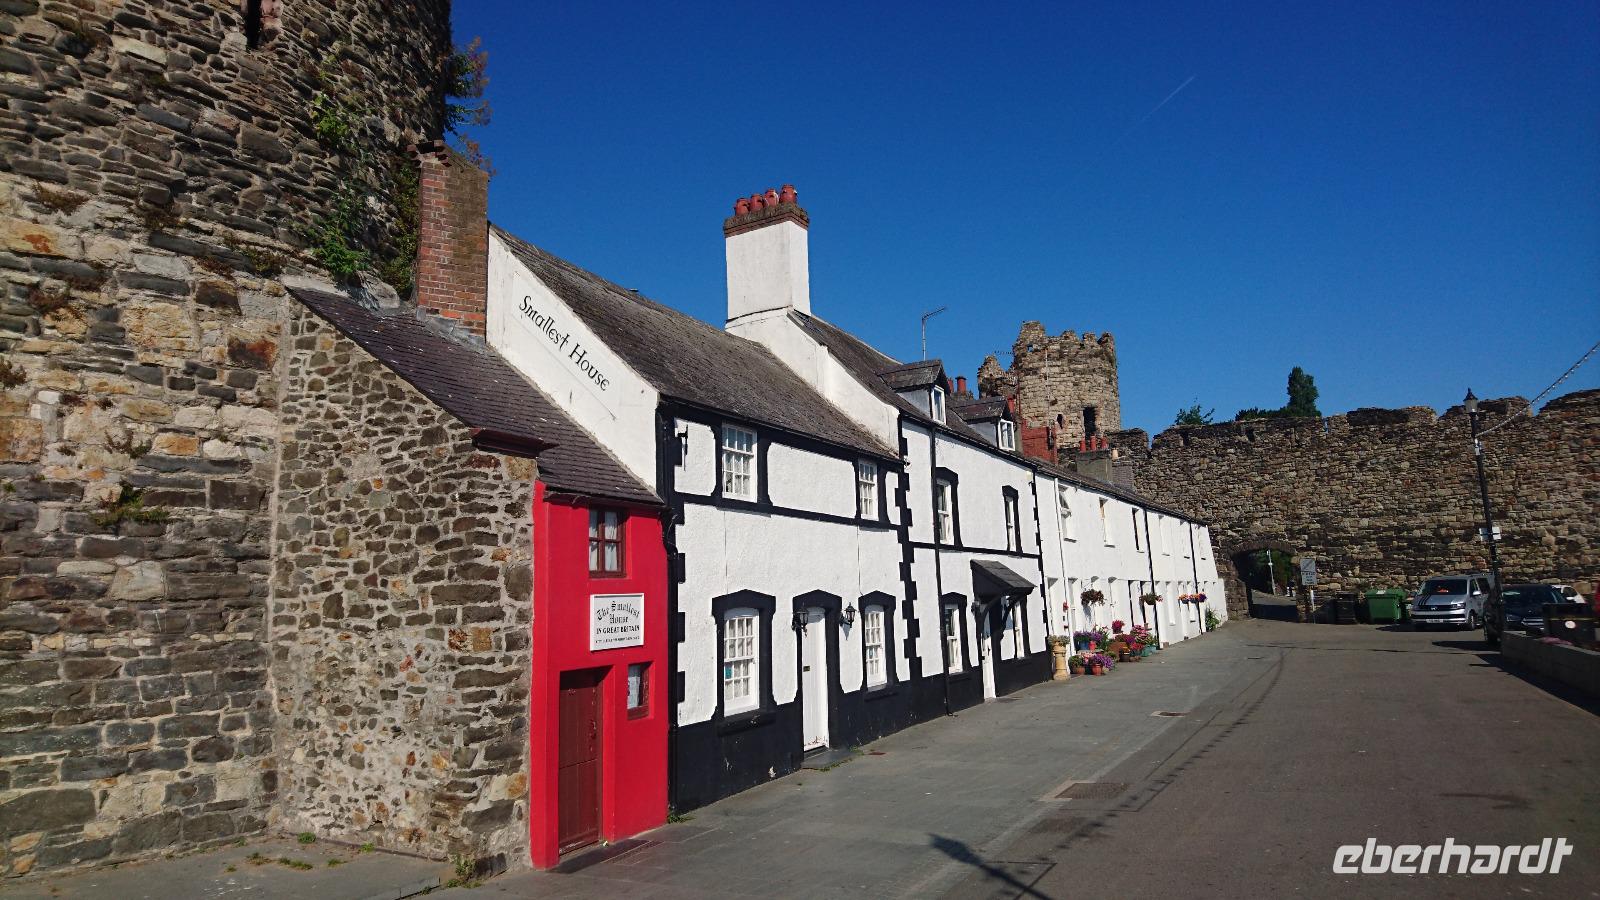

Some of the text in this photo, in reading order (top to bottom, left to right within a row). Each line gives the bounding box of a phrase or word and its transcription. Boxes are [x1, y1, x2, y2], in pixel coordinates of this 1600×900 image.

[518, 295, 610, 391] Smallest House
[611, 600, 640, 618] Smallest
[596, 625, 640, 635] IN GREAT BRITAIN
